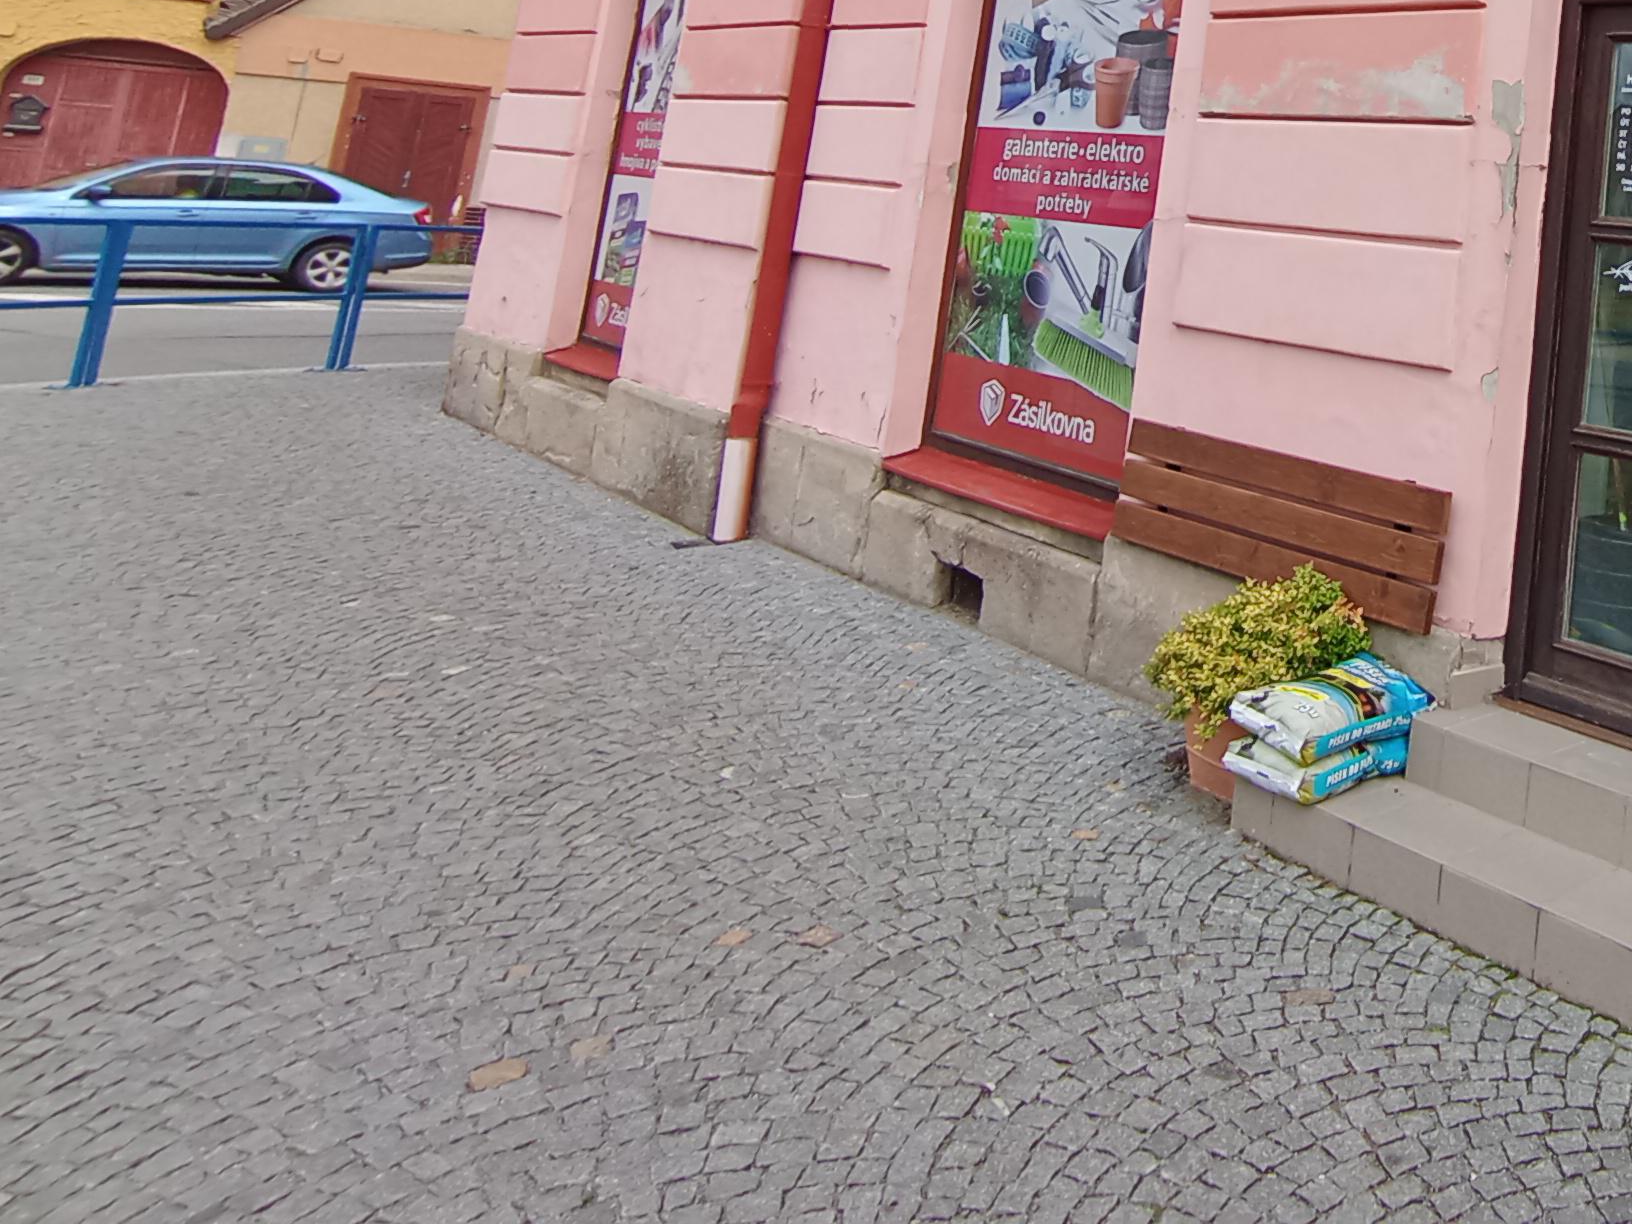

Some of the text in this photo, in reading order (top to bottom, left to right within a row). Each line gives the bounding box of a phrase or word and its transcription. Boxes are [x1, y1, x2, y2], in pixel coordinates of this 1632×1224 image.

[1085, 137, 1144, 164] elektro
[993, 162, 1149, 192] domácí a zahrádkářské
[1036, 192, 1092, 219] potřeby
[1008, 394, 1095, 444] Zásilkovna
